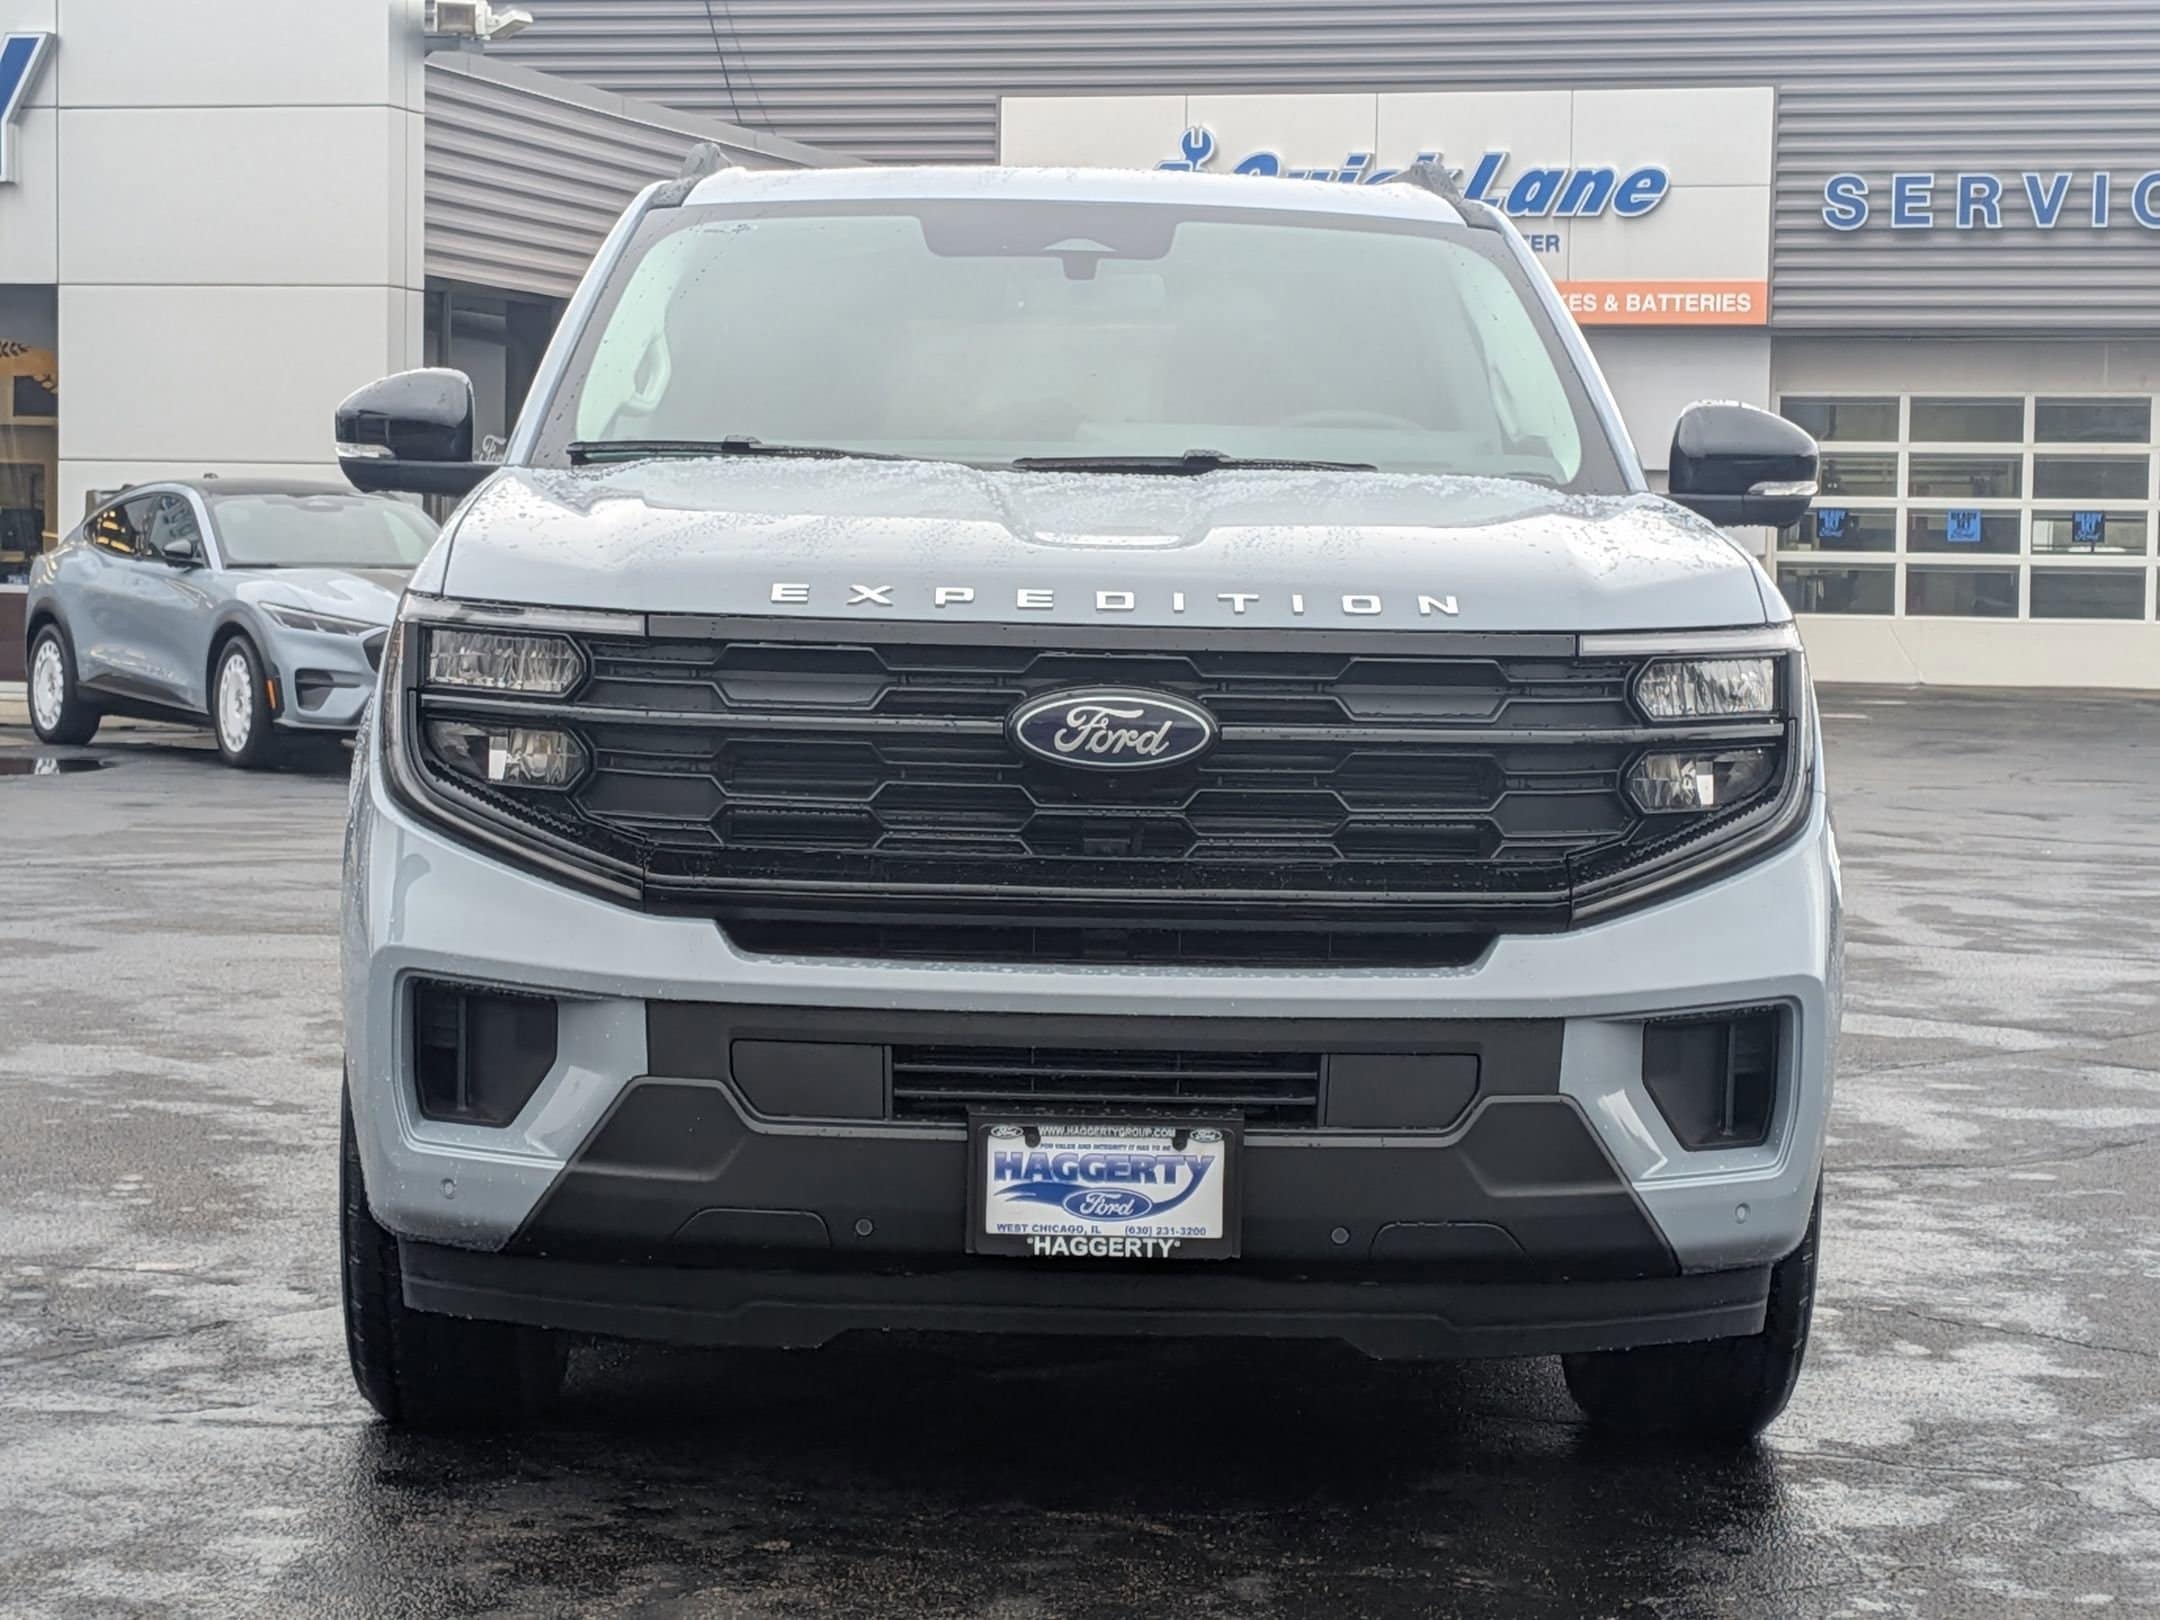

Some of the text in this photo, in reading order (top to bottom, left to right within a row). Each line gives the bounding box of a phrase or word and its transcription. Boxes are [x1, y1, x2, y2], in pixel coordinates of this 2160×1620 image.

[1605, 293, 1618, 312] &
[1626, 293, 1752, 312] BATTERIES
[770, 582, 1459, 616] EXPEDITION
[1054, 705, 1173, 757] Ford
[994, 1151, 1216, 1185] HAGGERTY
[1079, 1192, 1134, 1216] Ford
[997, 1223, 1102, 1235] WEST CHICAGO, IL
[1124, 1225, 1152, 1236] (630)
